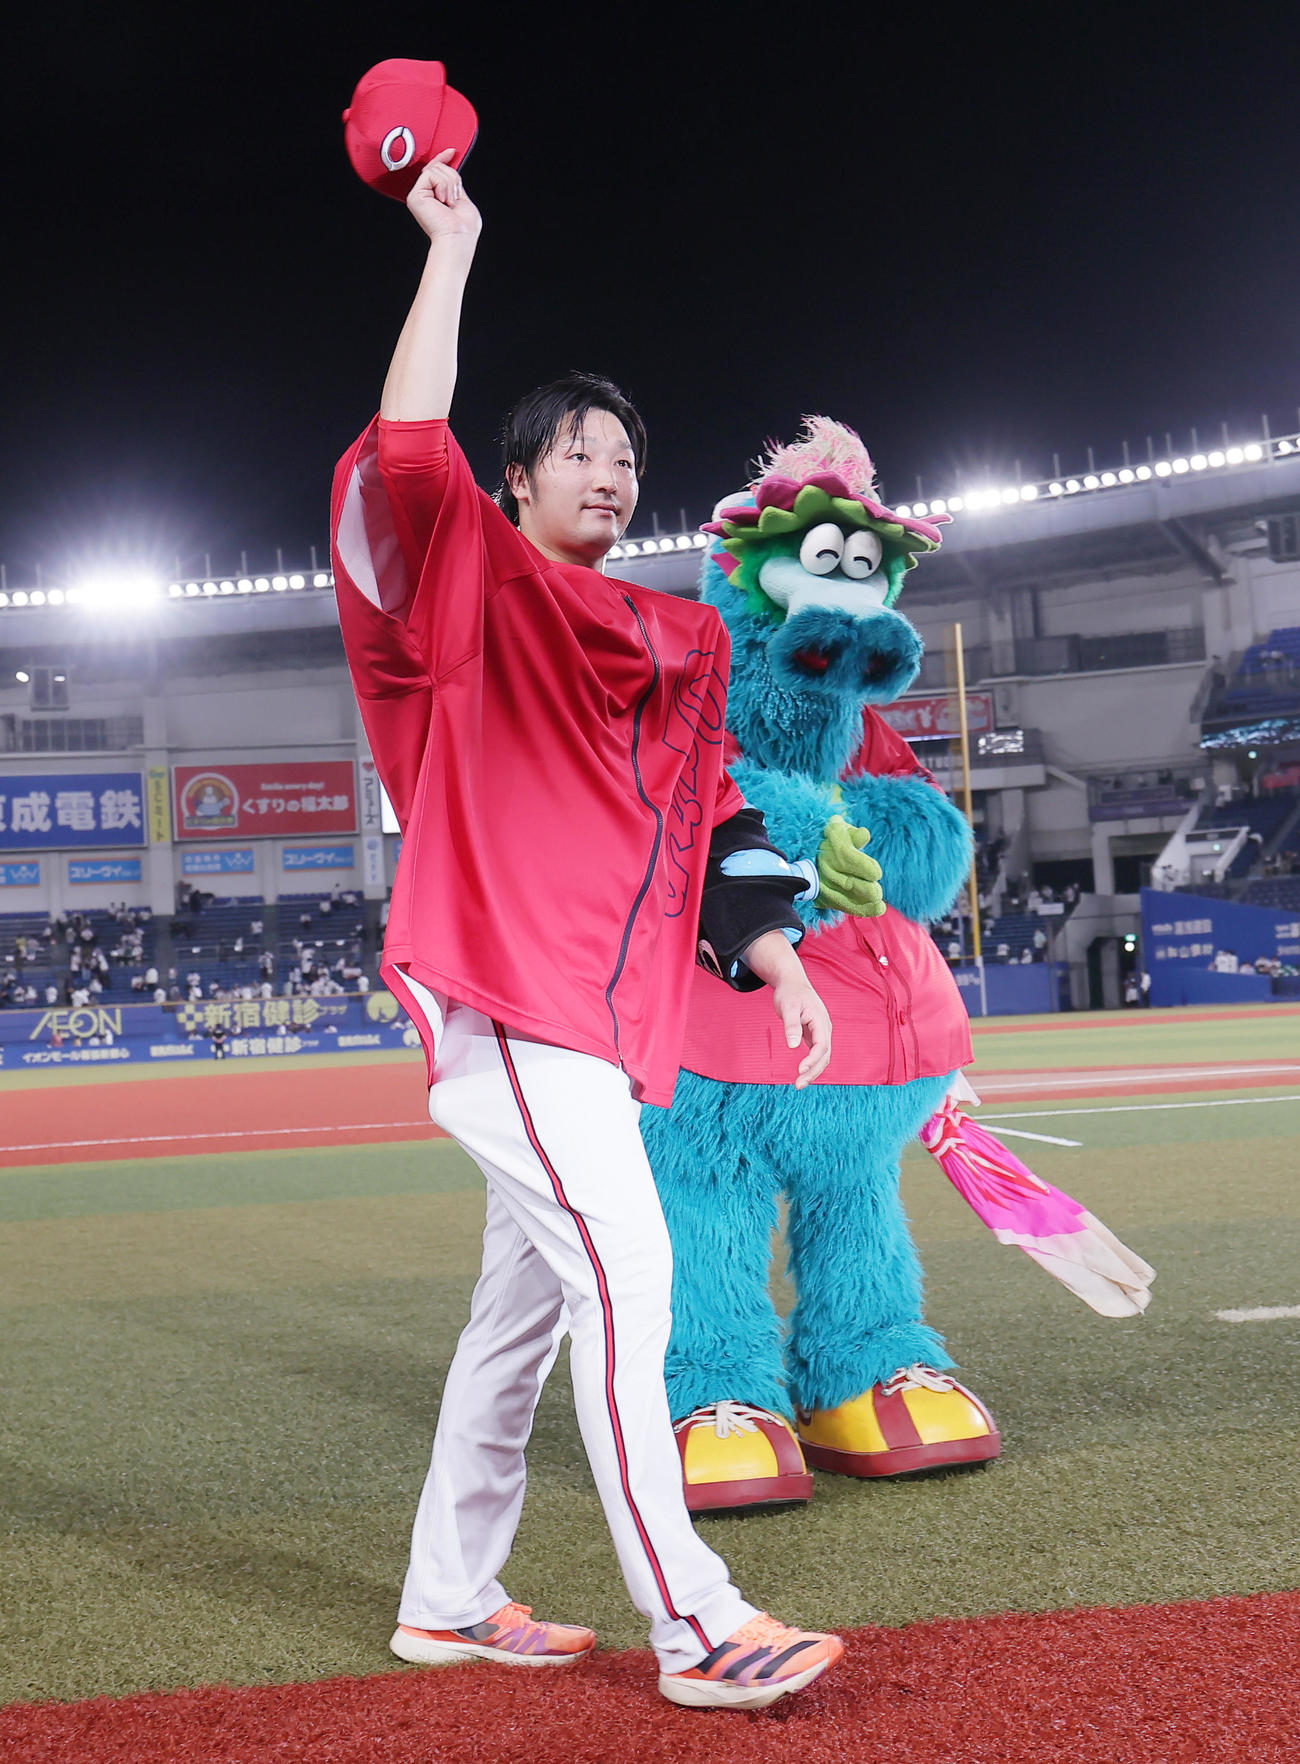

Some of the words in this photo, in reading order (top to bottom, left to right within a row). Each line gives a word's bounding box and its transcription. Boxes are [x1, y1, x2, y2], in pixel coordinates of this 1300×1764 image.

[242, 795, 349, 814] くすりの福太郎
